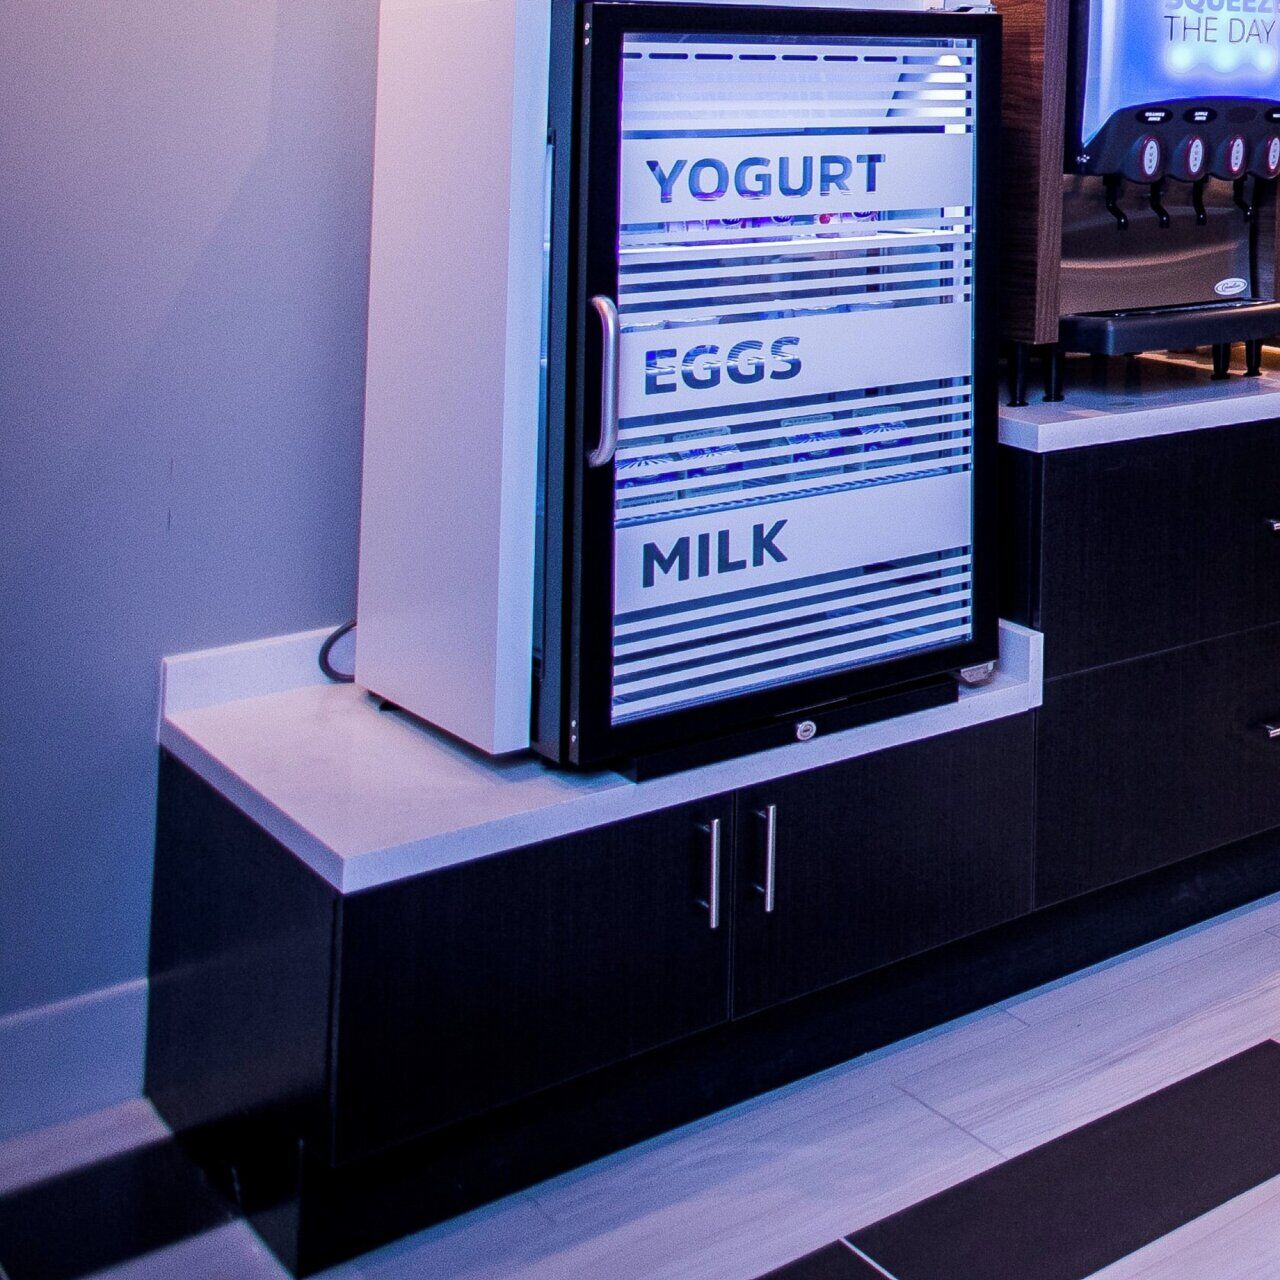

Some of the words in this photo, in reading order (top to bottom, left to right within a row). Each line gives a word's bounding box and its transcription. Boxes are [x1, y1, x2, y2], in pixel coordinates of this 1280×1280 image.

[1164, 15, 1218, 42] THE
[1229, 18, 1276, 43] DAY
[646, 154, 886, 203] YOGURT
[645, 336, 802, 396] EGGS
[643, 519, 788, 588] MILK
